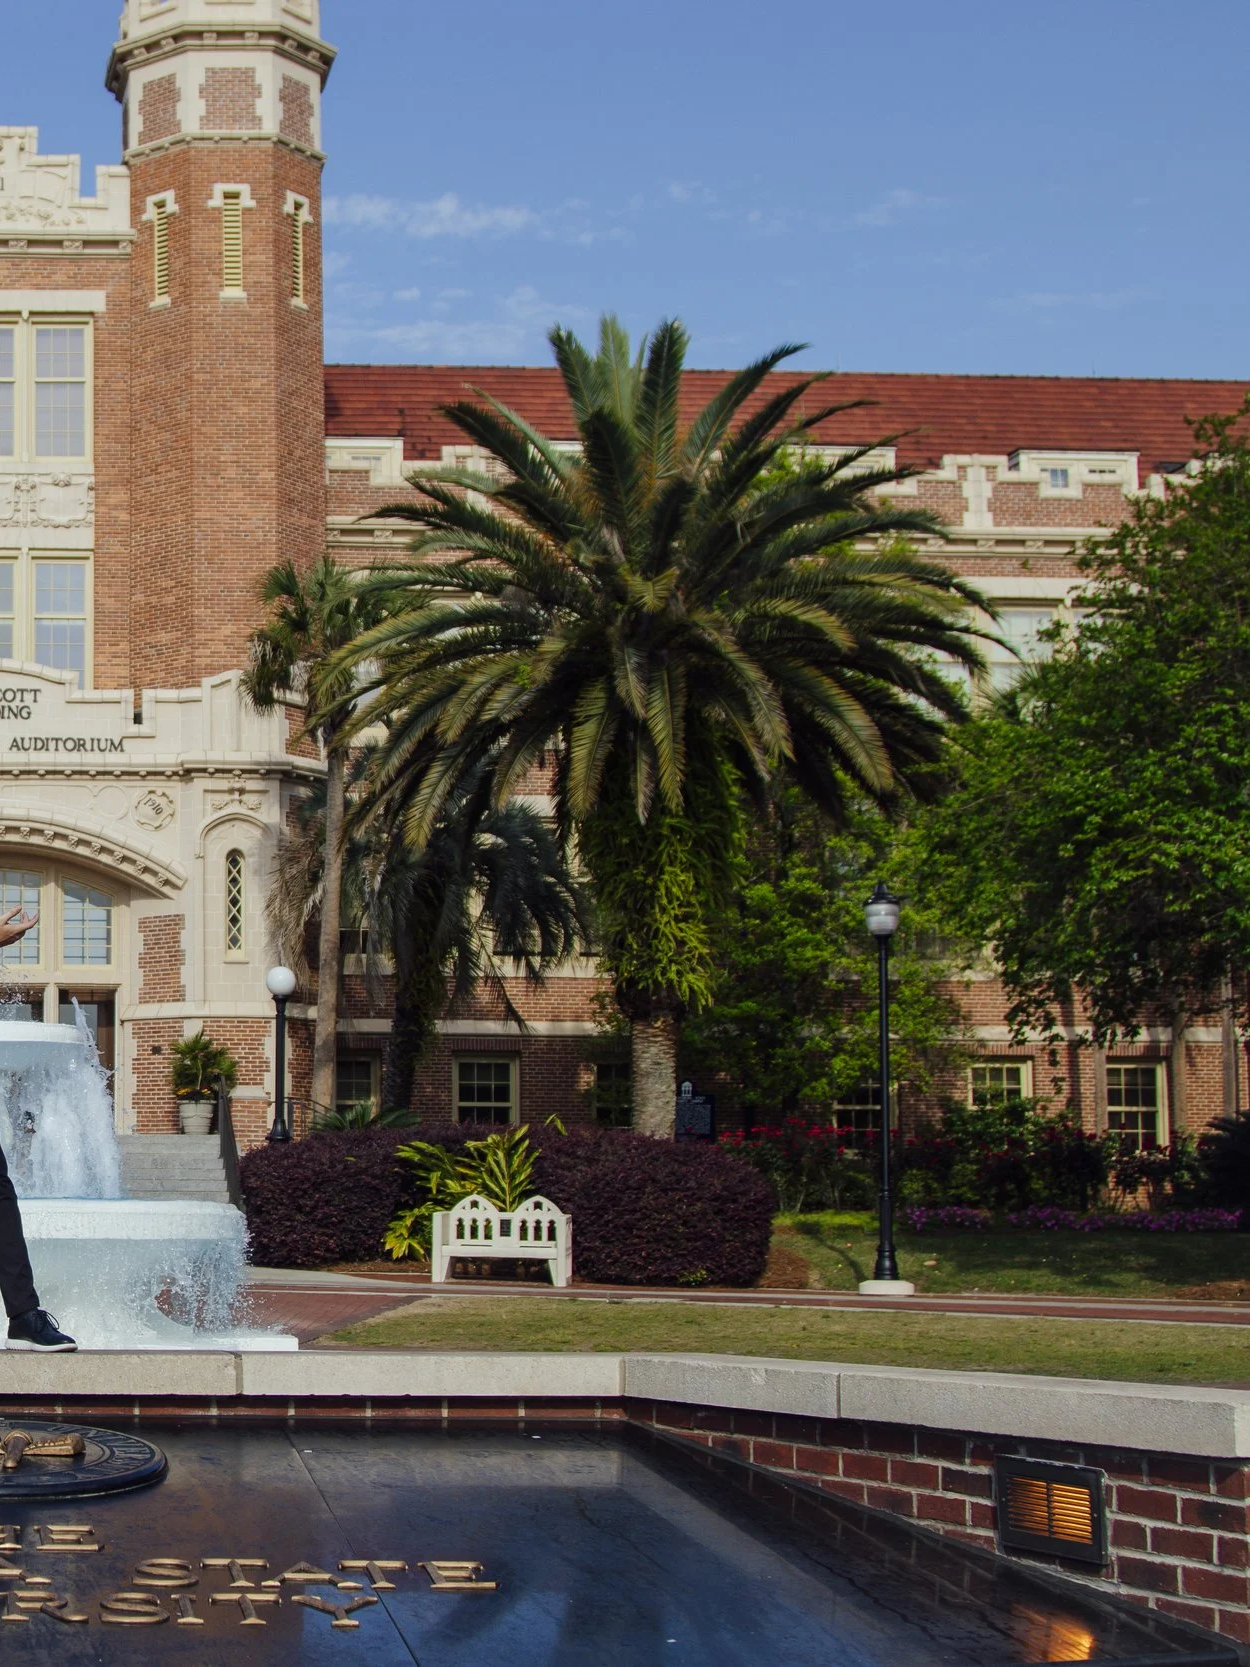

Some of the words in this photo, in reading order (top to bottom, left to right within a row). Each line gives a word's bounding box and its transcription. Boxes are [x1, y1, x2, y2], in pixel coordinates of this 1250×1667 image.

[9, 736, 125, 753] AUDITORIUM
[143, 797, 164, 815] 1910
[131, 1557, 501, 1592] STATE
